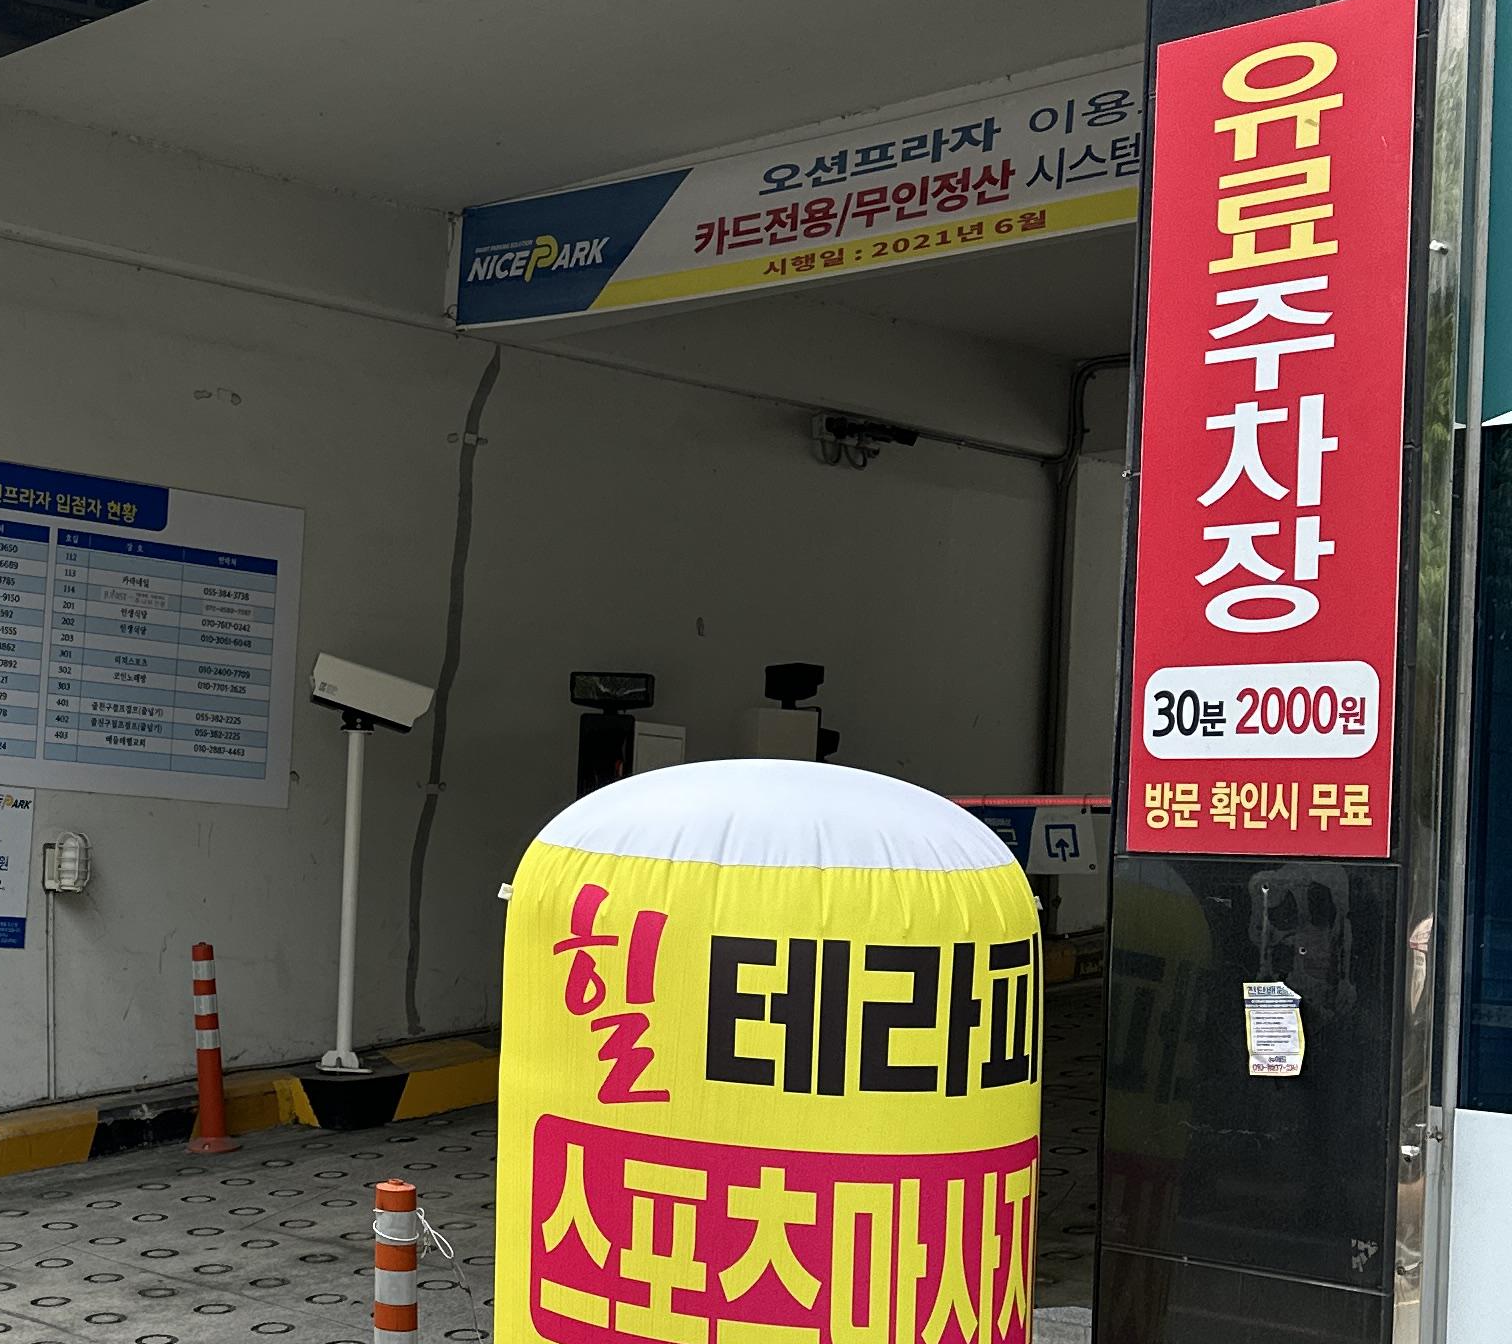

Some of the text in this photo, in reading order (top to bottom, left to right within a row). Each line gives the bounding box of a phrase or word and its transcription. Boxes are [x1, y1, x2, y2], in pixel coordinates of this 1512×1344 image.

[757, 89, 1143, 197] 오션프라자 이용
[693, 131, 1141, 257] 카드전용/무인정산 시스템
[763, 208, 1049, 277] 시행일 2021년 6월
[1194, 39, 1344, 635] 유료주차장
[56, 493, 102, 519] 입점자
[106, 500, 138, 524] 현황
[1151, 684, 1368, 739] 30분 2000원
[1144, 779, 1373, 832] 방문 확인시 무료
[552, 884, 1038, 1104] 힐 테라피
